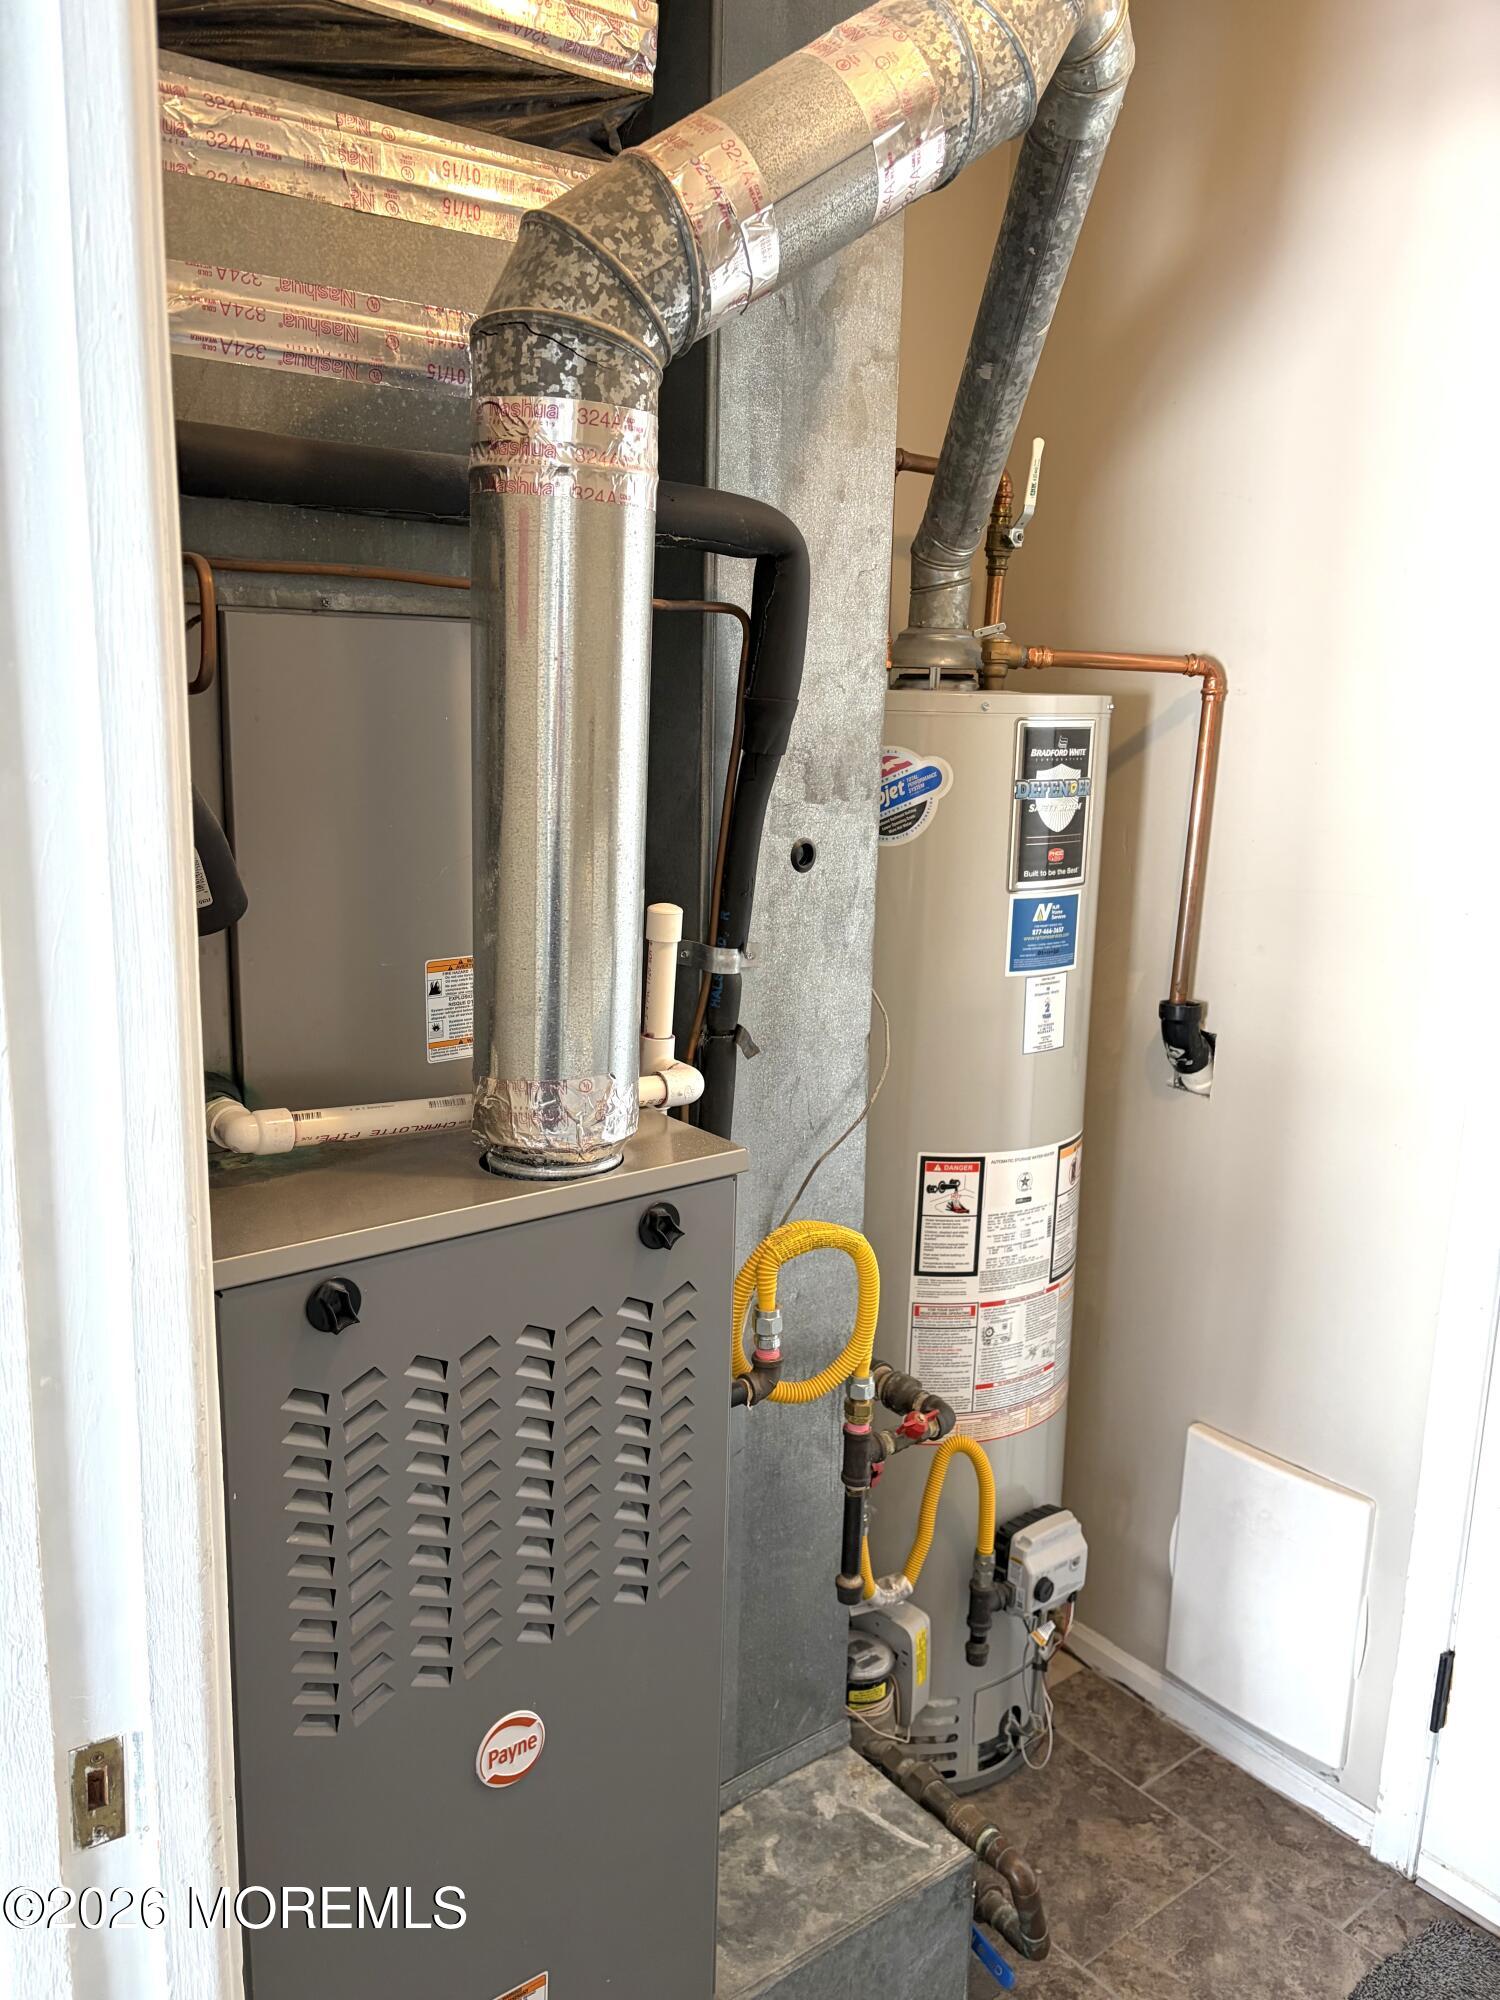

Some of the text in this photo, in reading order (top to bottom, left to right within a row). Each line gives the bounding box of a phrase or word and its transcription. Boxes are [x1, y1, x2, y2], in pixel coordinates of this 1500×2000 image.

[203, 93, 253, 116] 324A
[336, 112, 371, 137] Nas
[206, 130, 253, 156] 324A
[338, 147, 375, 174] Nas
[442, 160, 481, 184] 01/15
[442, 196, 481, 222] 01/15
[277, 277, 356, 309] Nashua
[220, 299, 266, 322] 324A
[190, 334, 218, 343] WEATHER
[281, 312, 359, 343] Nashua
[202, 343, 217, 351] COLD
[220, 337, 267, 360] 324A
[281, 351, 358, 380] Nashua
[427, 363, 466, 385] 01/15
[577, 407, 621, 429] 324A
[1030, 748, 1087, 757] BRADFORD WHITE
[1015, 779, 1091, 799] DEFENDER
[1044, 1002, 1051, 1012] 2
[320, 1120, 457, 1143] CHARLOTTE PIPE
[488, 1734, 538, 1769] Payne
